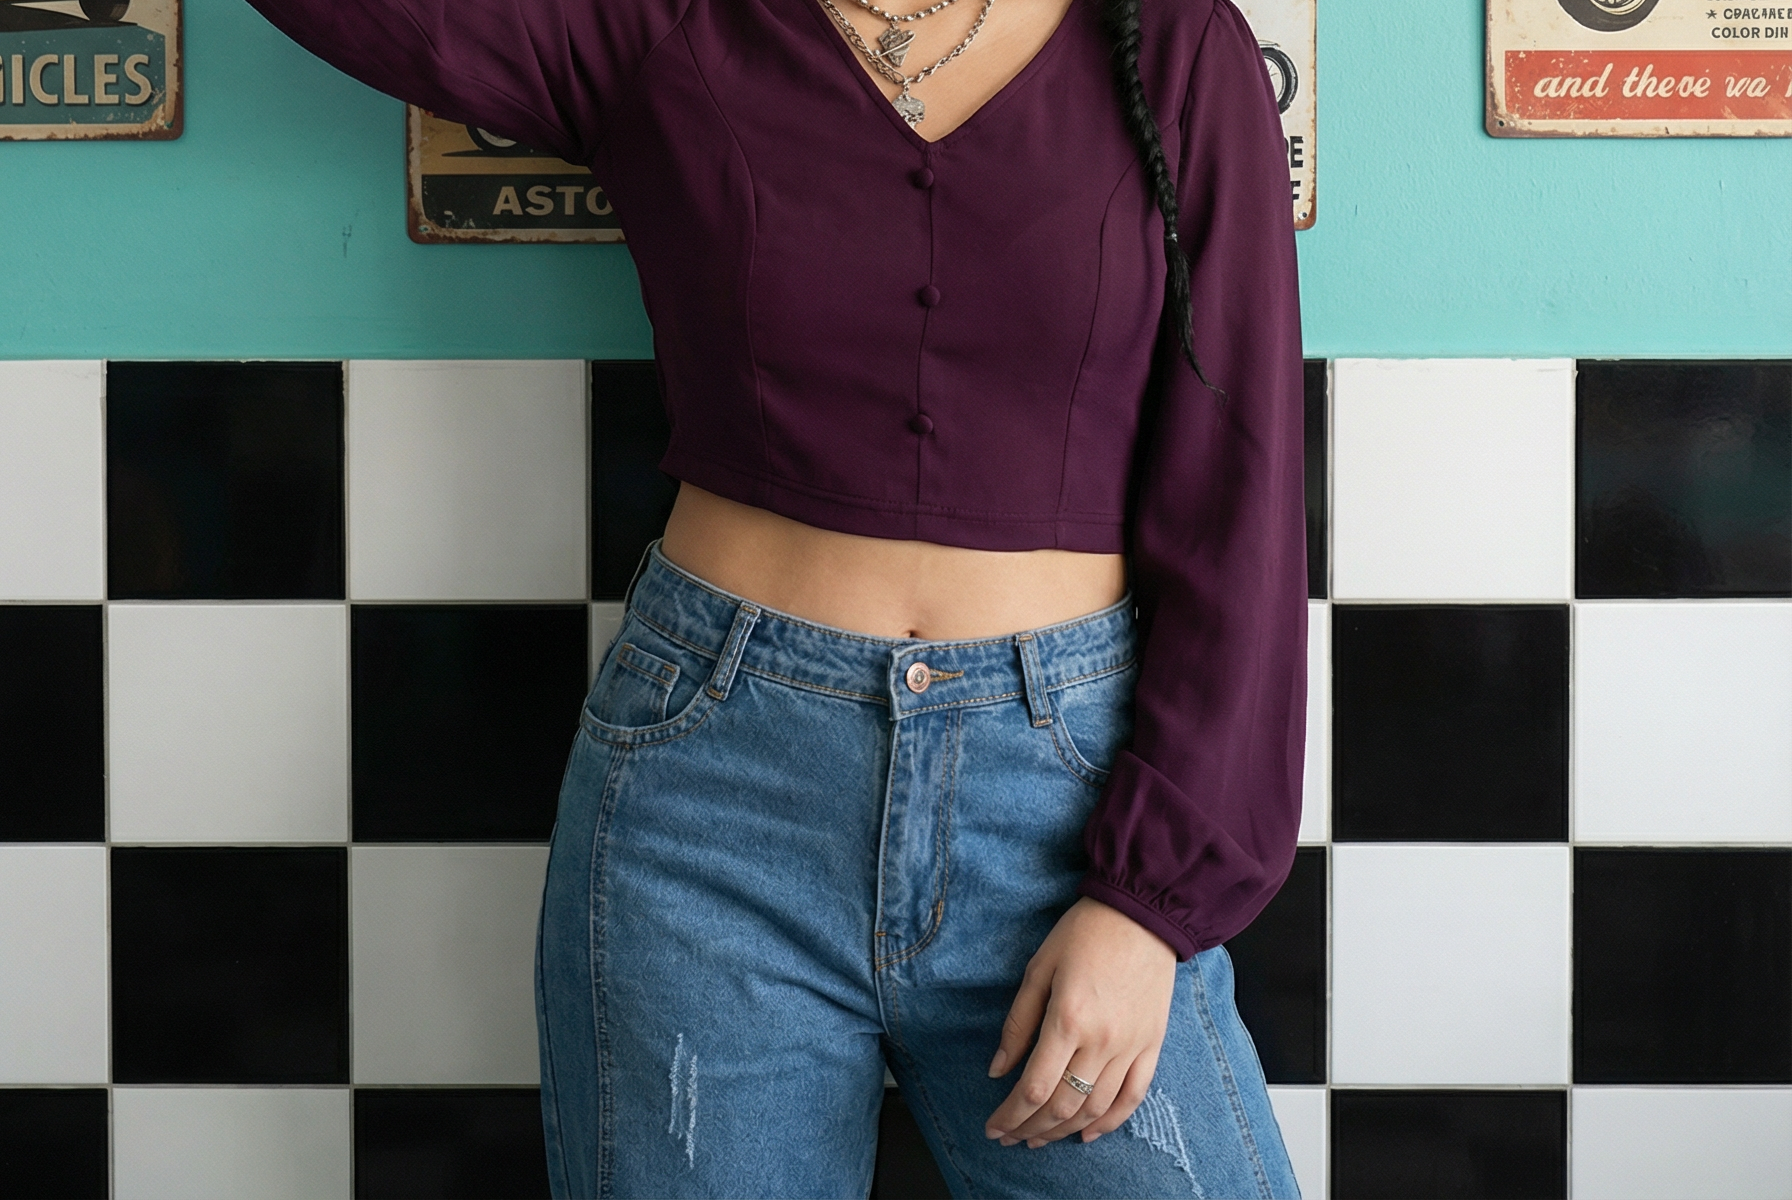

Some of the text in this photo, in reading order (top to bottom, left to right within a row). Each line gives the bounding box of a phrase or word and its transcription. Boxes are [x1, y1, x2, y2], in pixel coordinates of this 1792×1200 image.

[1711, 26, 1761, 39] COLOR
[0, 53, 152, 105] ICLES
[1533, 62, 1614, 98] and
